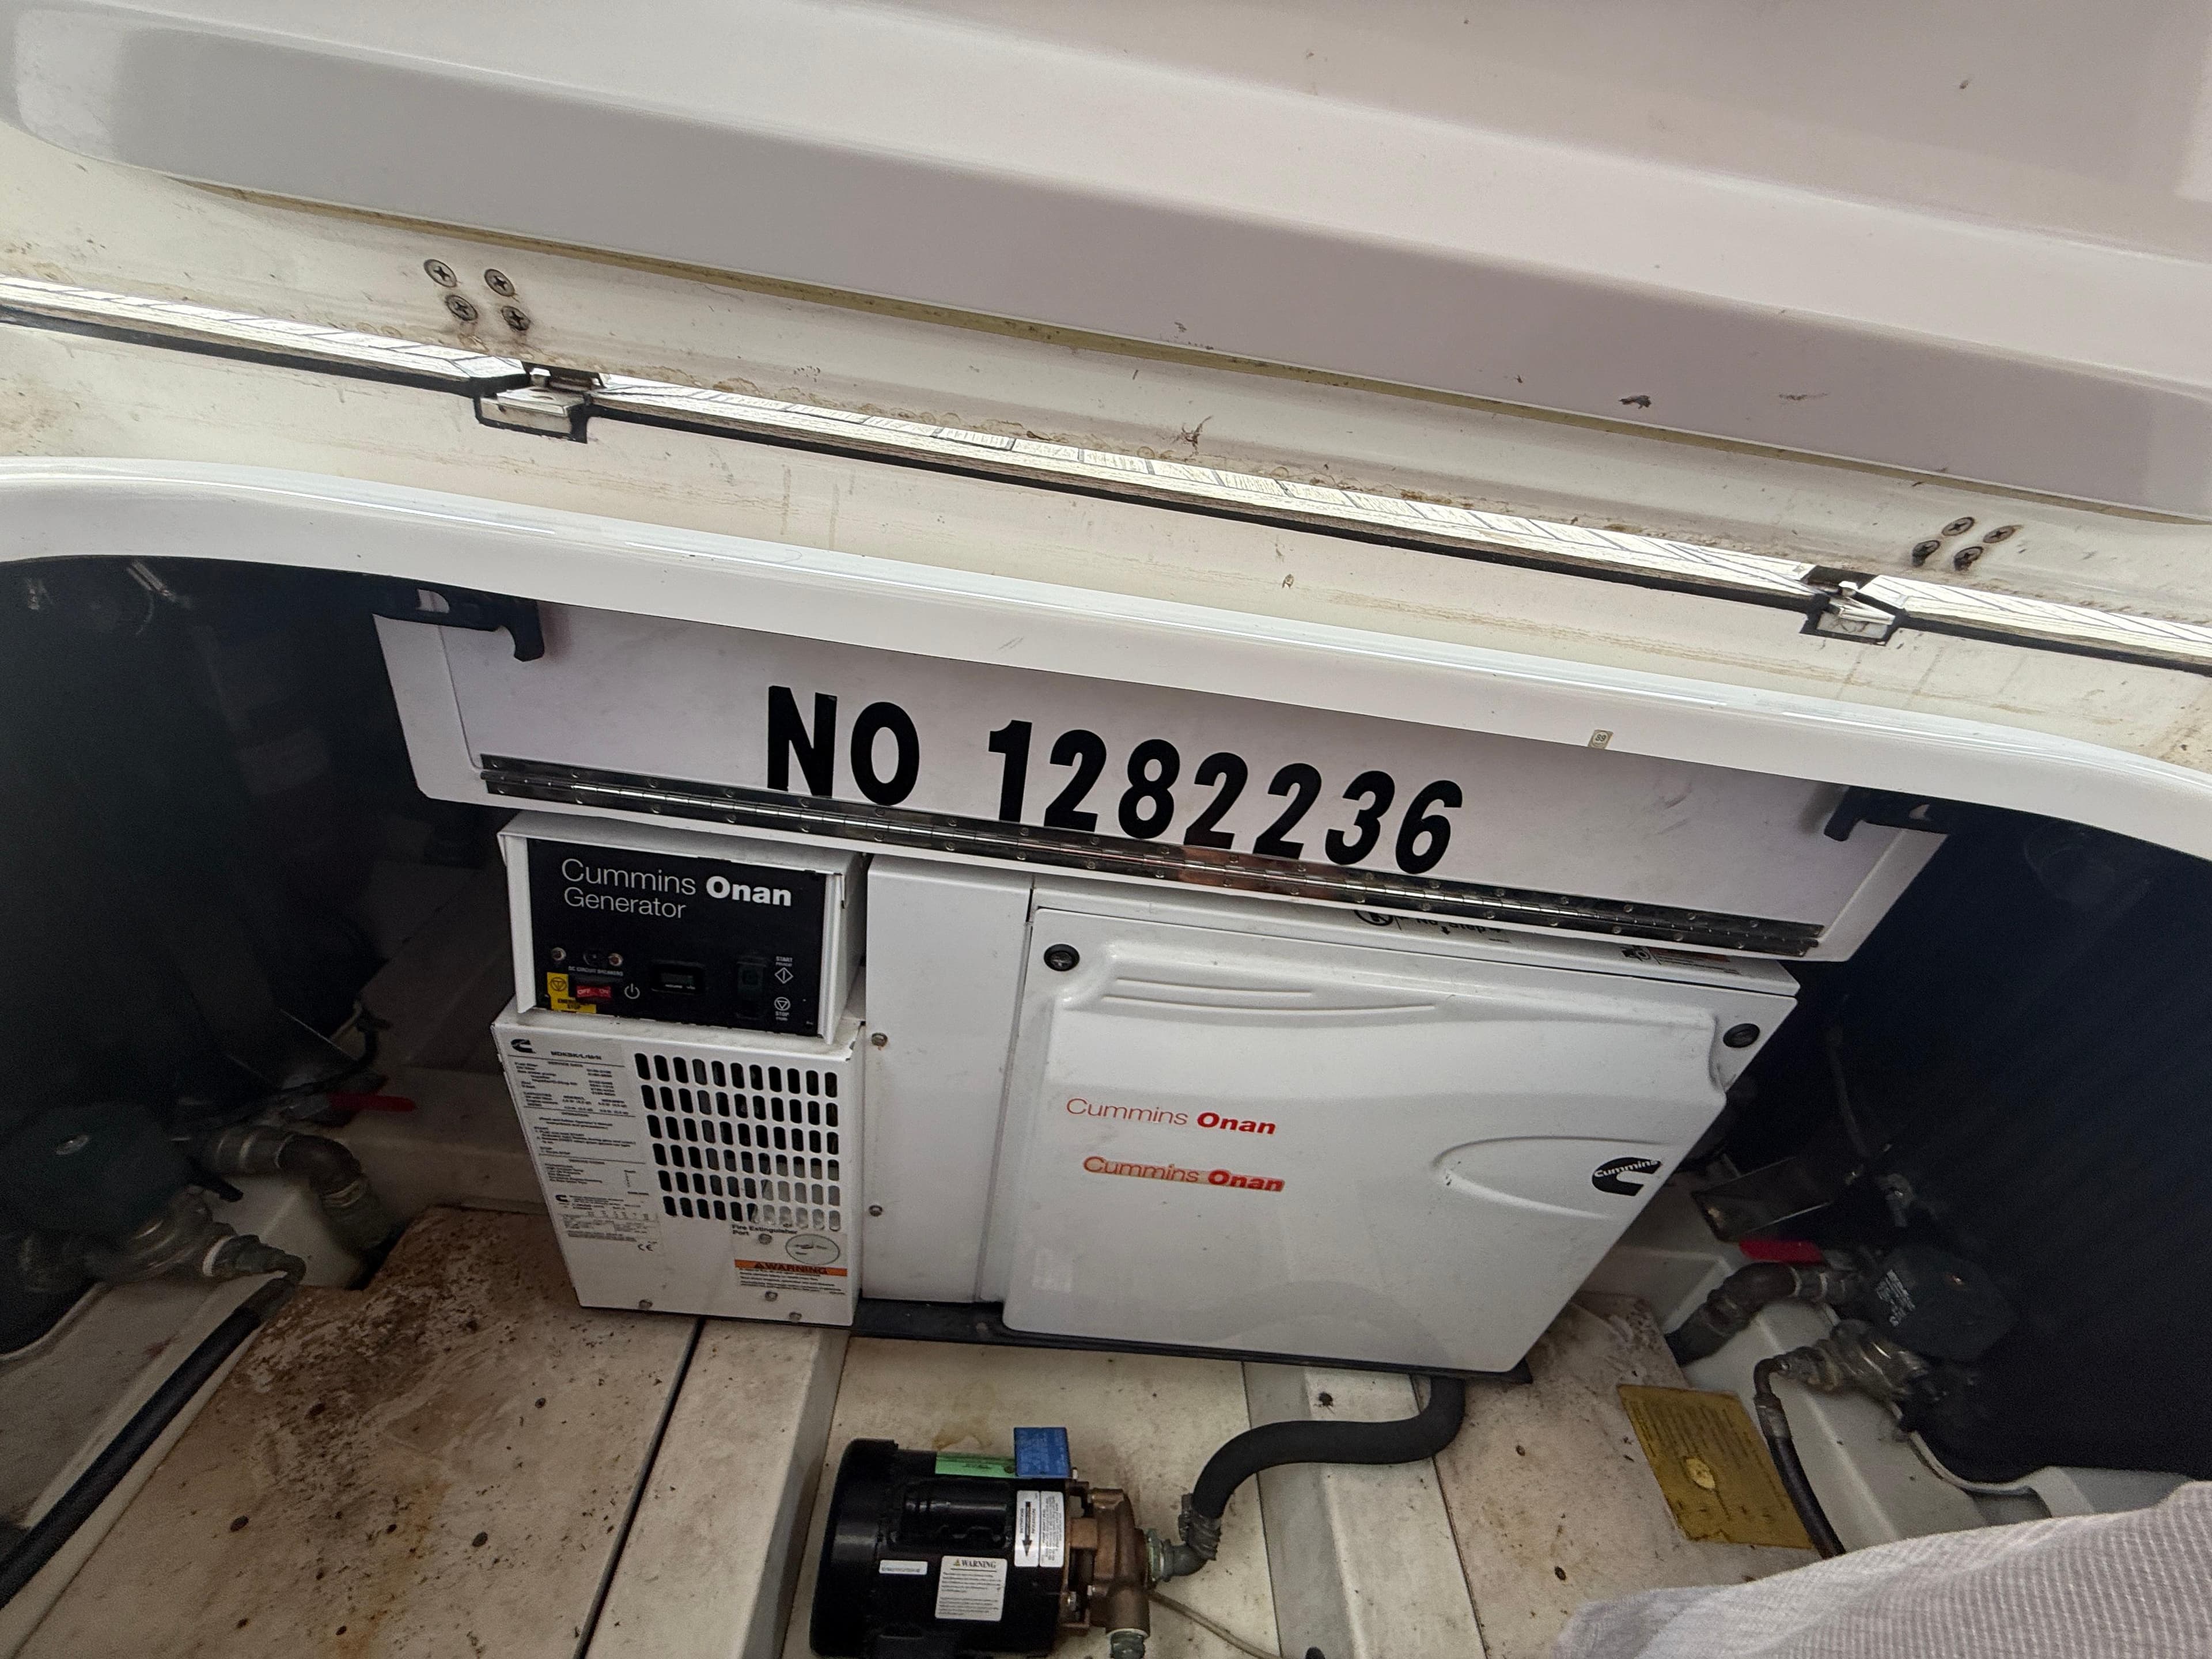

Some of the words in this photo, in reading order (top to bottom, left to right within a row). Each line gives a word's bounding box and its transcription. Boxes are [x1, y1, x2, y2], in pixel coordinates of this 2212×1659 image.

[767, 685, 920, 807] NO
[987, 719, 1463, 874] 1282236
[562, 858, 696, 895] Cummins
[706, 876, 792, 907] Onan
[563, 887, 687, 919] Generator
[1066, 1097, 1188, 1126] Cummins
[1197, 1112, 1276, 1135] Onan
[1083, 1155, 1199, 1183] Cummins
[1208, 1169, 1285, 1192] Onan
[1594, 1160, 1658, 1178] Cummins
[749, 1226, 797, 1234] Extinguisher
[765, 1263, 828, 1274] WARNING
[961, 1559, 997, 1569] WARNING
